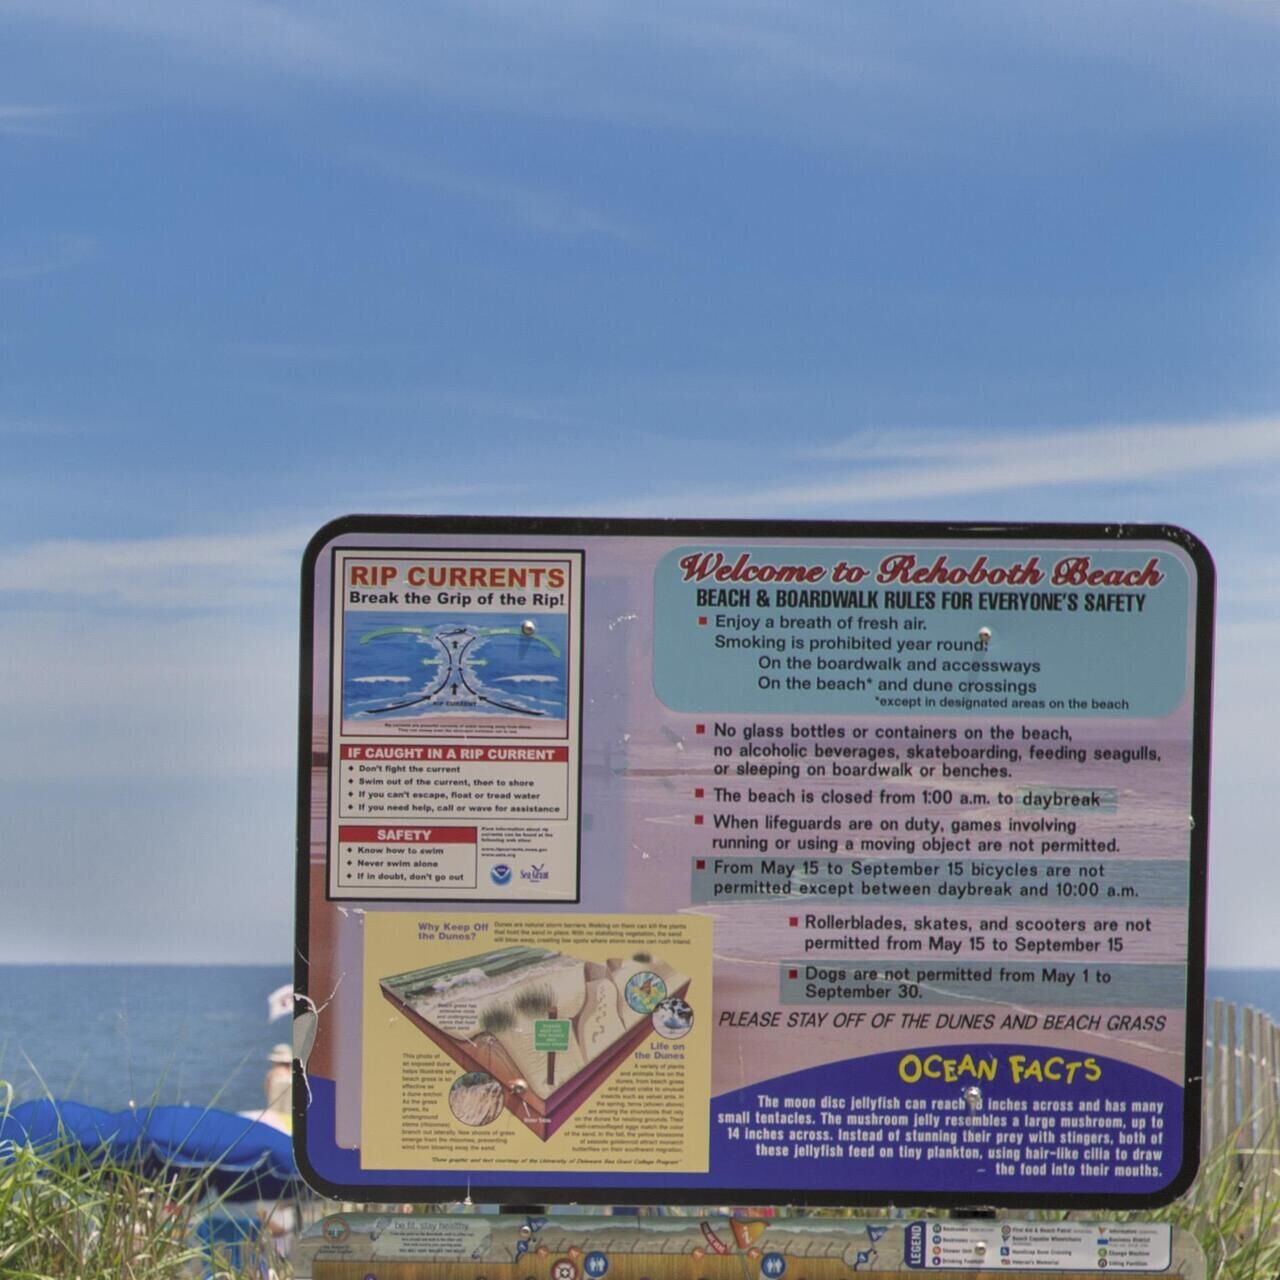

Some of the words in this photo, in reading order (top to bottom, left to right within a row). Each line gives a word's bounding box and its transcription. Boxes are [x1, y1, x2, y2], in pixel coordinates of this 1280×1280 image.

[351, 566, 397, 586] RIP
[408, 567, 565, 588] CURRENTS
[679, 552, 827, 582] Welcome
[832, 561, 868, 582] to
[876, 554, 1044, 585] Rehoboth
[1050, 556, 1164, 586] Beach
[350, 592, 398, 604] Break
[405, 592, 430, 604] the
[437, 592, 471, 607] Grip
[478, 593, 493, 605] of
[500, 593, 526, 605] the
[533, 594, 564, 608] Rip!
[697, 589, 750, 607] BEACH
[756, 590, 770, 608] &
[776, 590, 878, 609] BOARDWALK
[885, 591, 935, 609] RULES
[942, 591, 972, 610] FOR
[978, 592, 1078, 611] EVERYONE'S
[1084, 593, 1146, 612] SAFETY
[715, 615, 760, 630] Enjoy
[765, 618, 774, 628] a
[780, 615, 831, 629] breath
[837, 616, 854, 629] of
[858, 616, 898, 630] fresh
[904, 616, 927, 630] air.
[925, 697, 935, 706] in
[939, 697, 1007, 710] designated
[1011, 700, 1044, 709] areas
[1049, 701, 1064, 709] on
[1068, 699, 1087, 709] the
[1092, 699, 1129, 710] beach
[714, 723, 736, 737] No
[744, 724, 784, 740] glass
[790, 724, 845, 738] bottles
[852, 728, 868, 738] or
[875, 725, 956, 739] containers
[964, 729, 983, 739] on
[990, 726, 1014, 739] the
[1022, 726, 1072, 741] beach,
[348, 748, 360, 758] IF
[365, 748, 422, 759] CAUGHT
[428, 748, 441, 759] IN
[446, 749, 456, 759] A
[460, 749, 484, 759] RIP
[488, 749, 555, 760] CURRENT
[359, 765, 382, 773] Don't
[386, 765, 405, 774] fight
[408, 765, 423, 773] the
[359, 778, 384, 786] Swim
[404, 778, 414, 786] of
[435, 779, 470, 787] current,
[473, 779, 494, 787] then
[714, 788, 741, 802] The
[748, 788, 795, 803] beach
[801, 789, 814, 803] is
[821, 790, 873, 803] closed
[880, 790, 915, 804] from
[923, 790, 952, 804] 1:00
[960, 794, 990, 804] a.m.
[998, 792, 1013, 804] to
[1022, 792, 1100, 809] daybreak
[377, 830, 432, 841] SAFETY
[357, 860, 384, 868] Never
[714, 860, 753, 874] From
[761, 861, 795, 878] May
[803, 861, 819, 874] 15
[828, 862, 843, 875] to
[851, 862, 939, 878] September
[948, 863, 963, 876] 15
[972, 862, 1038, 880] bicycles
[1046, 866, 1071, 876] are
[1079, 865, 1104, 876] not
[418, 922, 441, 932] Why
[444, 922, 469, 933] Keep
[474, 923, 489, 931] Off
[418, 932, 435, 940] the
[438, 932, 476, 941] Dunes?
[806, 967, 846, 982] Dogs
[854, 970, 877, 980] are
[885, 969, 909, 980] not
[917, 967, 992, 984] permitted
[1000, 968, 1034, 982] from
[1042, 969, 1075, 986] May
[1083, 969, 1089, 982] 1
[1096, 971, 1111, 983] to
[806, 984, 891, 1001] September
[898, 985, 923, 999] 30.
[719, 1011, 782, 1027] PLEASE
[787, 1012, 828, 1028] STAY
[833, 1013, 866, 1028] OFF
[871, 1013, 895, 1028] OF
[901, 1014, 931, 1028] THE
[936, 1014, 995, 1029] DUNES
[1000, 1014, 1037, 1030] AND
[1042, 1015, 1100, 1030] BEACH
[1106, 1015, 1166, 1031] GRASS
[650, 1042, 669, 1051] Life
[635, 1051, 654, 1060] the
[658, 1051, 685, 1060] Dunes
[899, 1054, 998, 1083] OCEAN
[1009, 1055, 1102, 1084] FACTS
[718, 1112, 750, 1124] small
[756, 1112, 815, 1124] tentacles.
[821, 1113, 841, 1124] The
[847, 1113, 908, 1125] mushroom
[914, 1113, 939, 1128] jelly
[945, 1114, 1006, 1126] resembles
[1013, 1118, 1019, 1127] a
[1025, 1115, 1055, 1129] large
[1060, 1116, 1126, 1129] mushroom,
[1132, 1118, 1145, 1130] up
[1152, 1116, 1163, 1128] to
[996, 1163, 1015, 1175] the
[1020, 1163, 1046, 1175] food
[1052, 1163, 1075, 1176] into
[1081, 1163, 1109, 1176] their
[1114, 1164, 1162, 1176] mouths.
[910, 1225, 921, 1264] LEGEND
